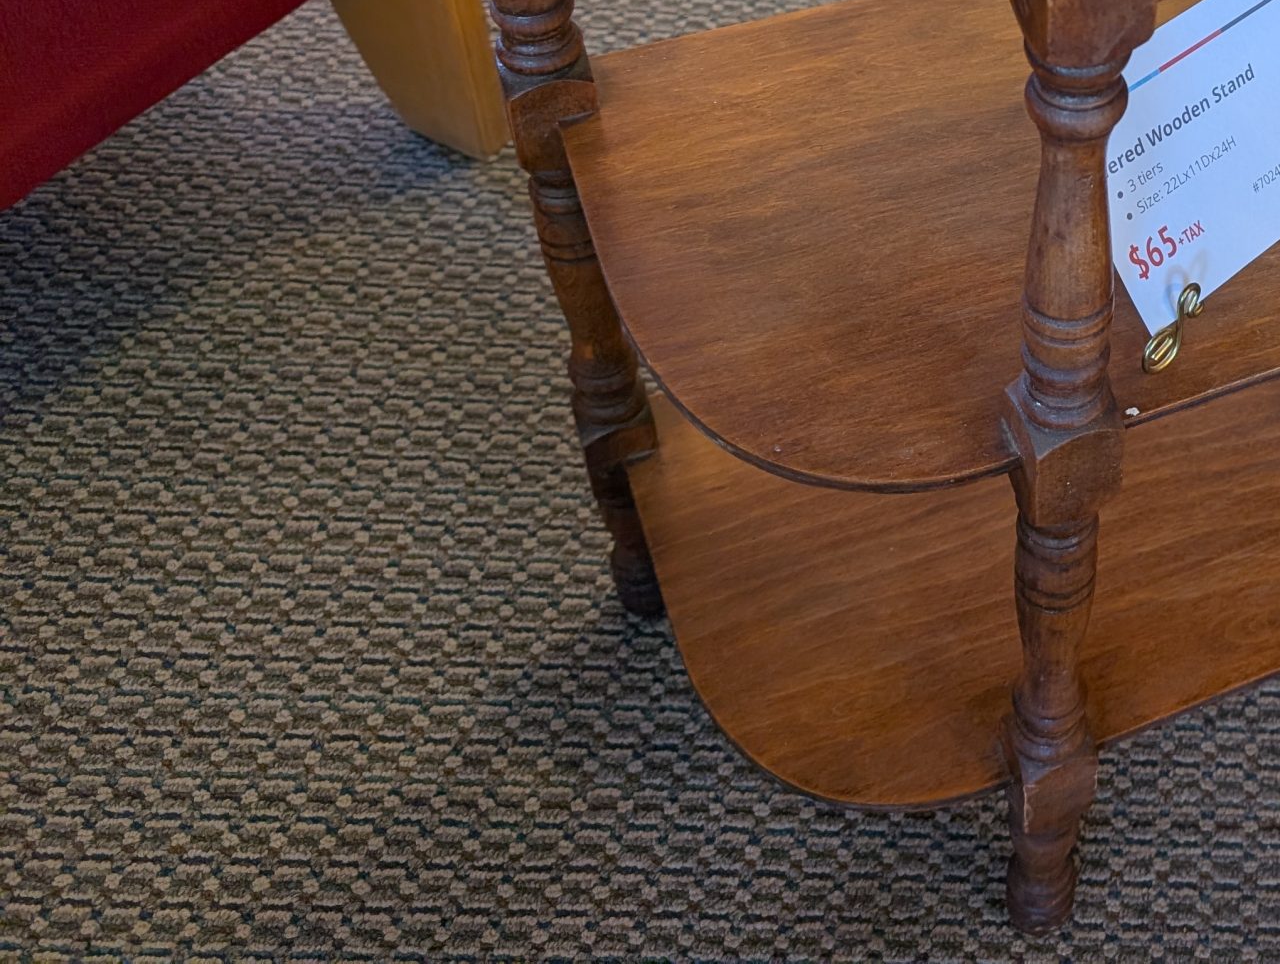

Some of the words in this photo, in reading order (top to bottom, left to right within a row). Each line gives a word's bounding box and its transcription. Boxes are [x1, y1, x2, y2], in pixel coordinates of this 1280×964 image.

[1106, 138, 1145, 178] ered
[1146, 97, 1210, 147] Wooden
[1212, 63, 1255, 103] Stand
[1128, 179, 1137, 193] 3
[1138, 162, 1164, 186] tiers
[1137, 190, 1164, 214] Size:
[1163, 135, 1237, 195] 22Lx11Dx24H
